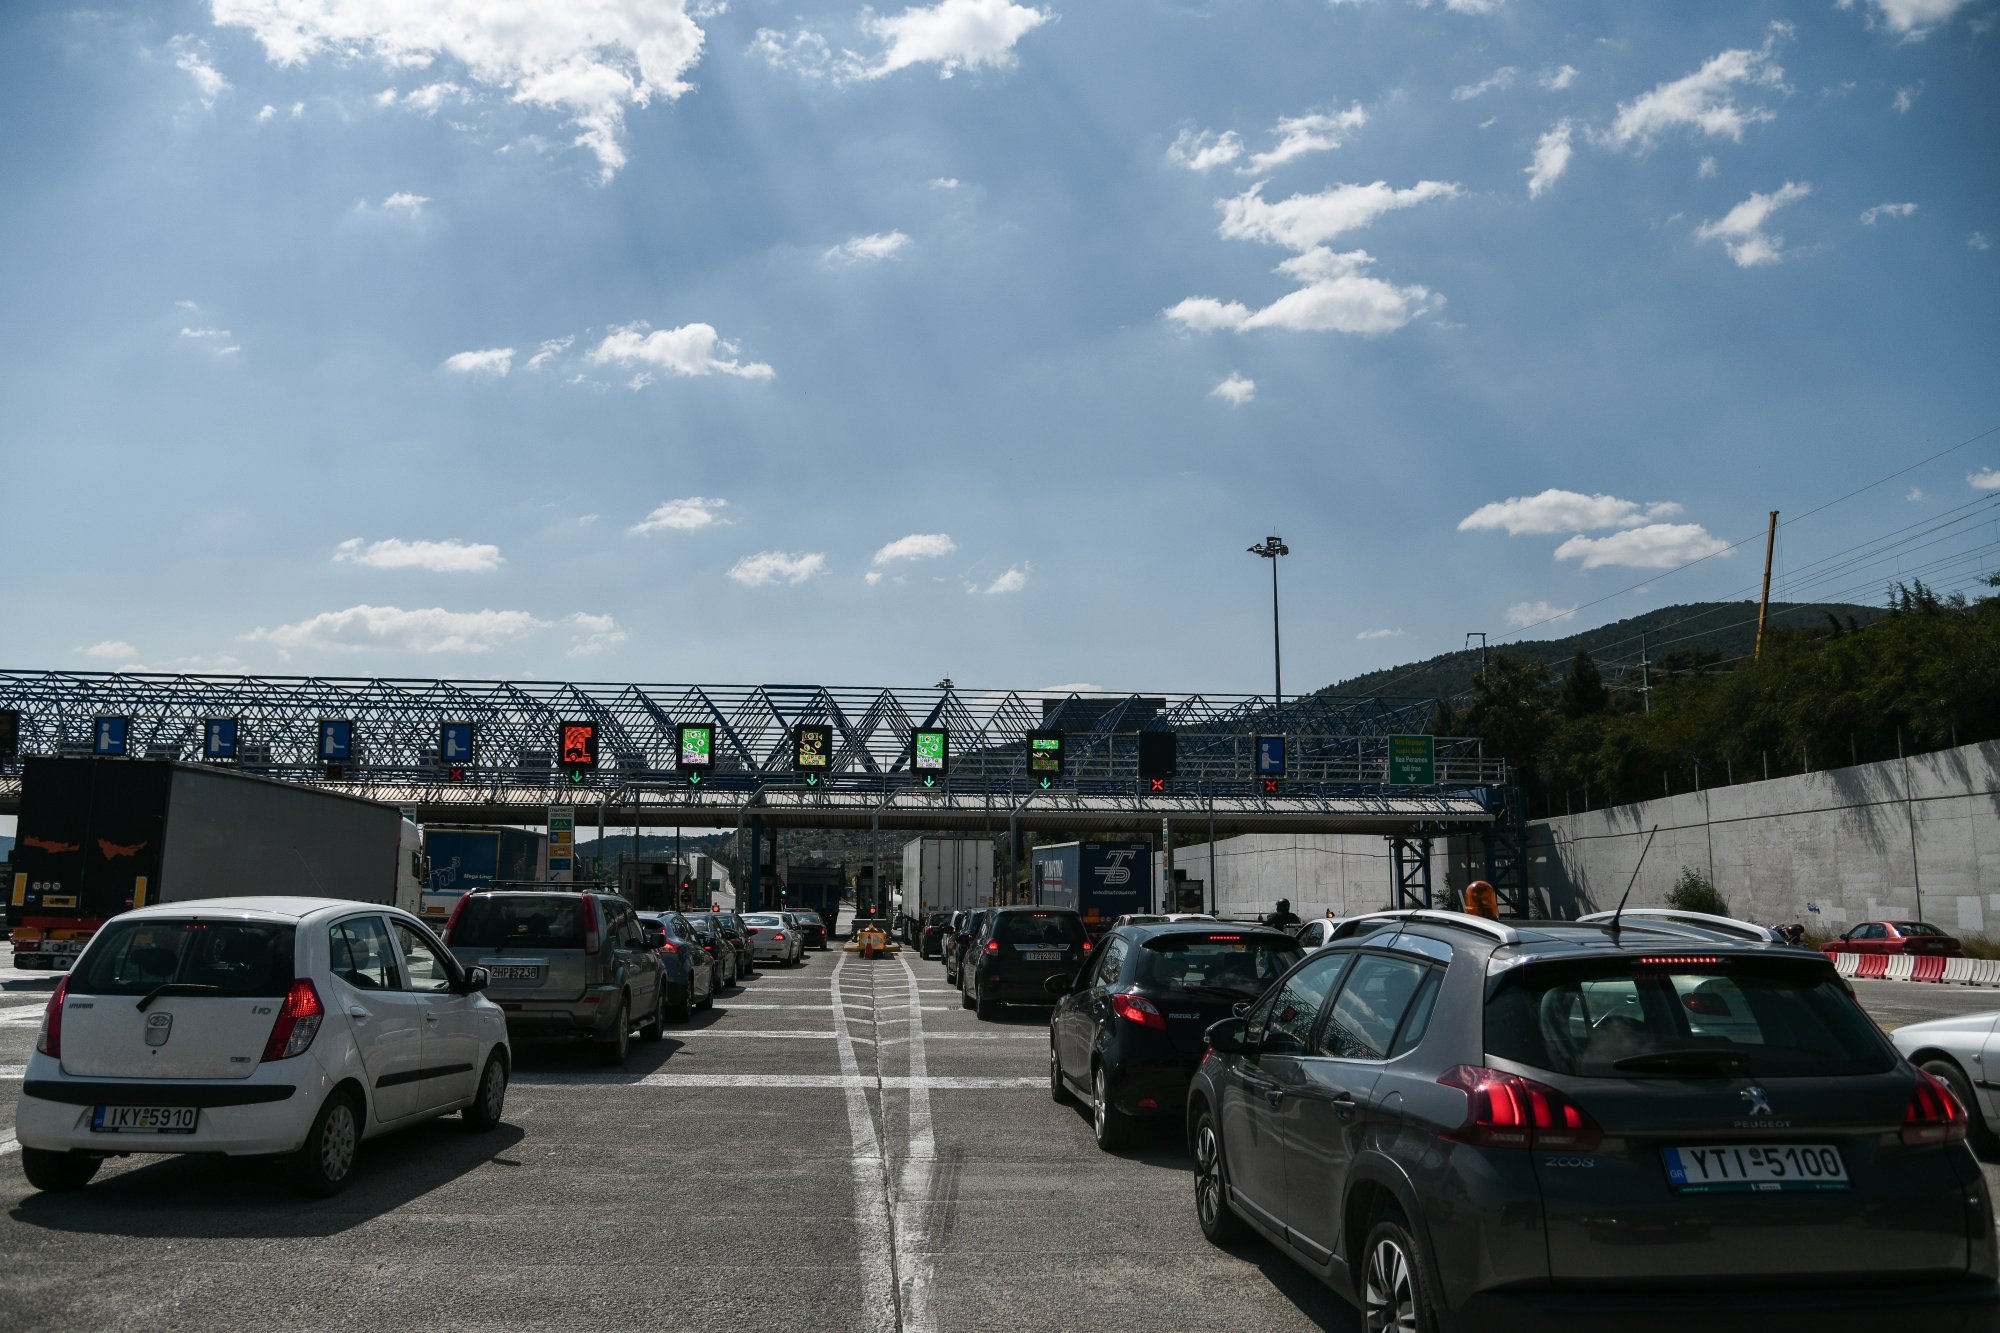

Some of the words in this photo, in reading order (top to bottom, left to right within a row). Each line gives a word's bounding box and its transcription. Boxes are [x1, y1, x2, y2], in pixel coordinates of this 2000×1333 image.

[1733, 1120, 1792, 1128] PEUGEOT
[1544, 1157, 1595, 1168] 2008
[1670, 1170, 1685, 1178] GR
